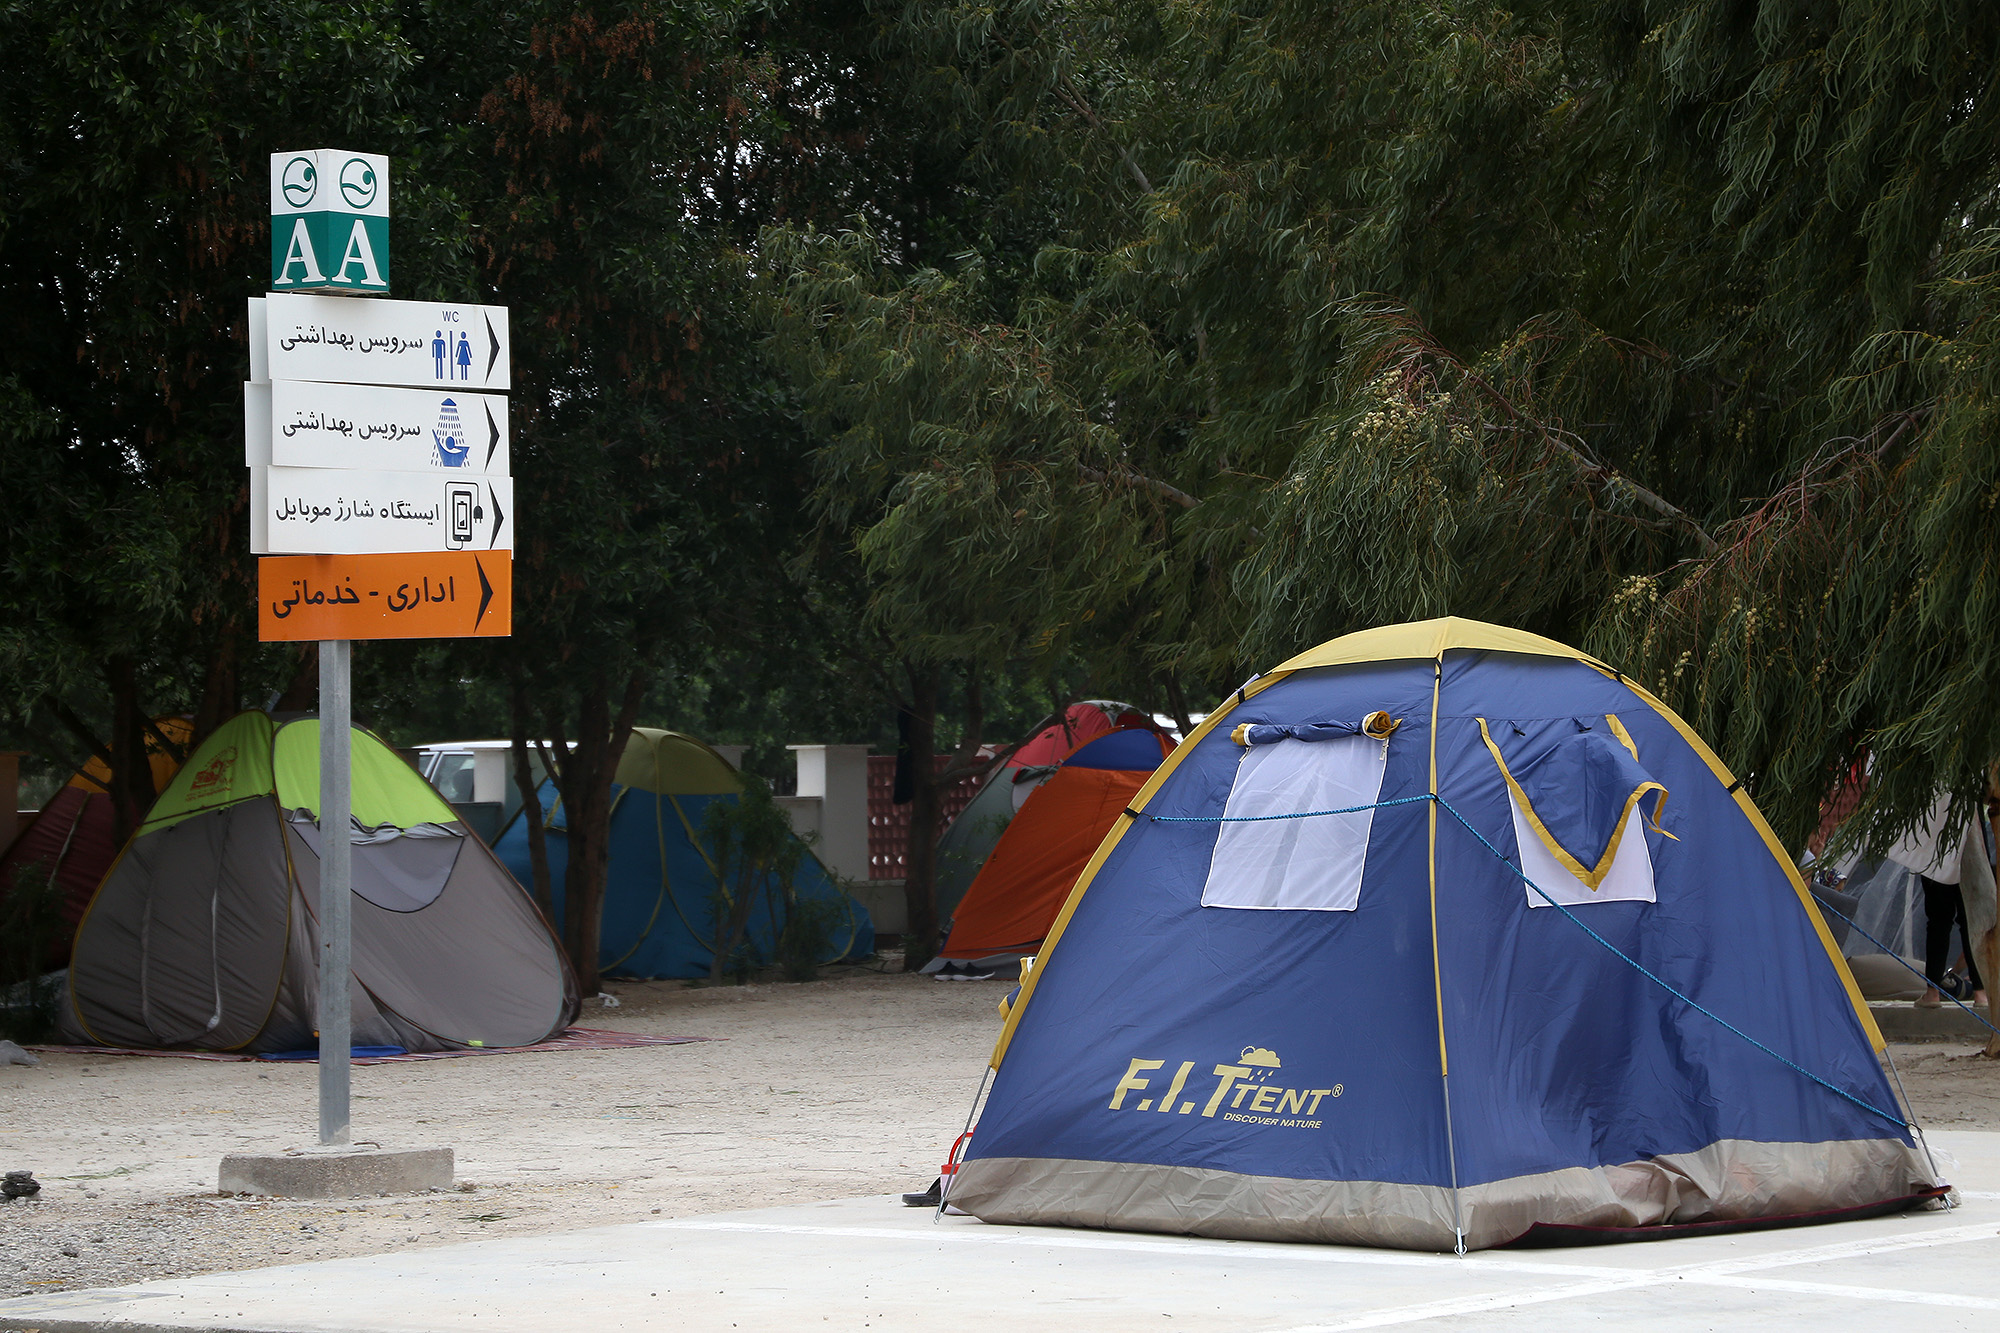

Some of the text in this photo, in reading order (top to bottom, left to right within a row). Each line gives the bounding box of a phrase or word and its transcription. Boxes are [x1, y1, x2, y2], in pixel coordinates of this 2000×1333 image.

[274, 217, 327, 286] A
[331, 219, 387, 287] A
[441, 310, 460, 323] WC
[280, 325, 423, 354] سرویس بهداشتی
[282, 411, 421, 441] سرویس بهداشتی
[275, 497, 440, 525] ایستگاه شارژ موبایل
[272, 577, 361, 620] خدماتی
[387, 575, 455, 613] اداری
[1223, 1112, 1323, 1129] DISCOVER NATURE
